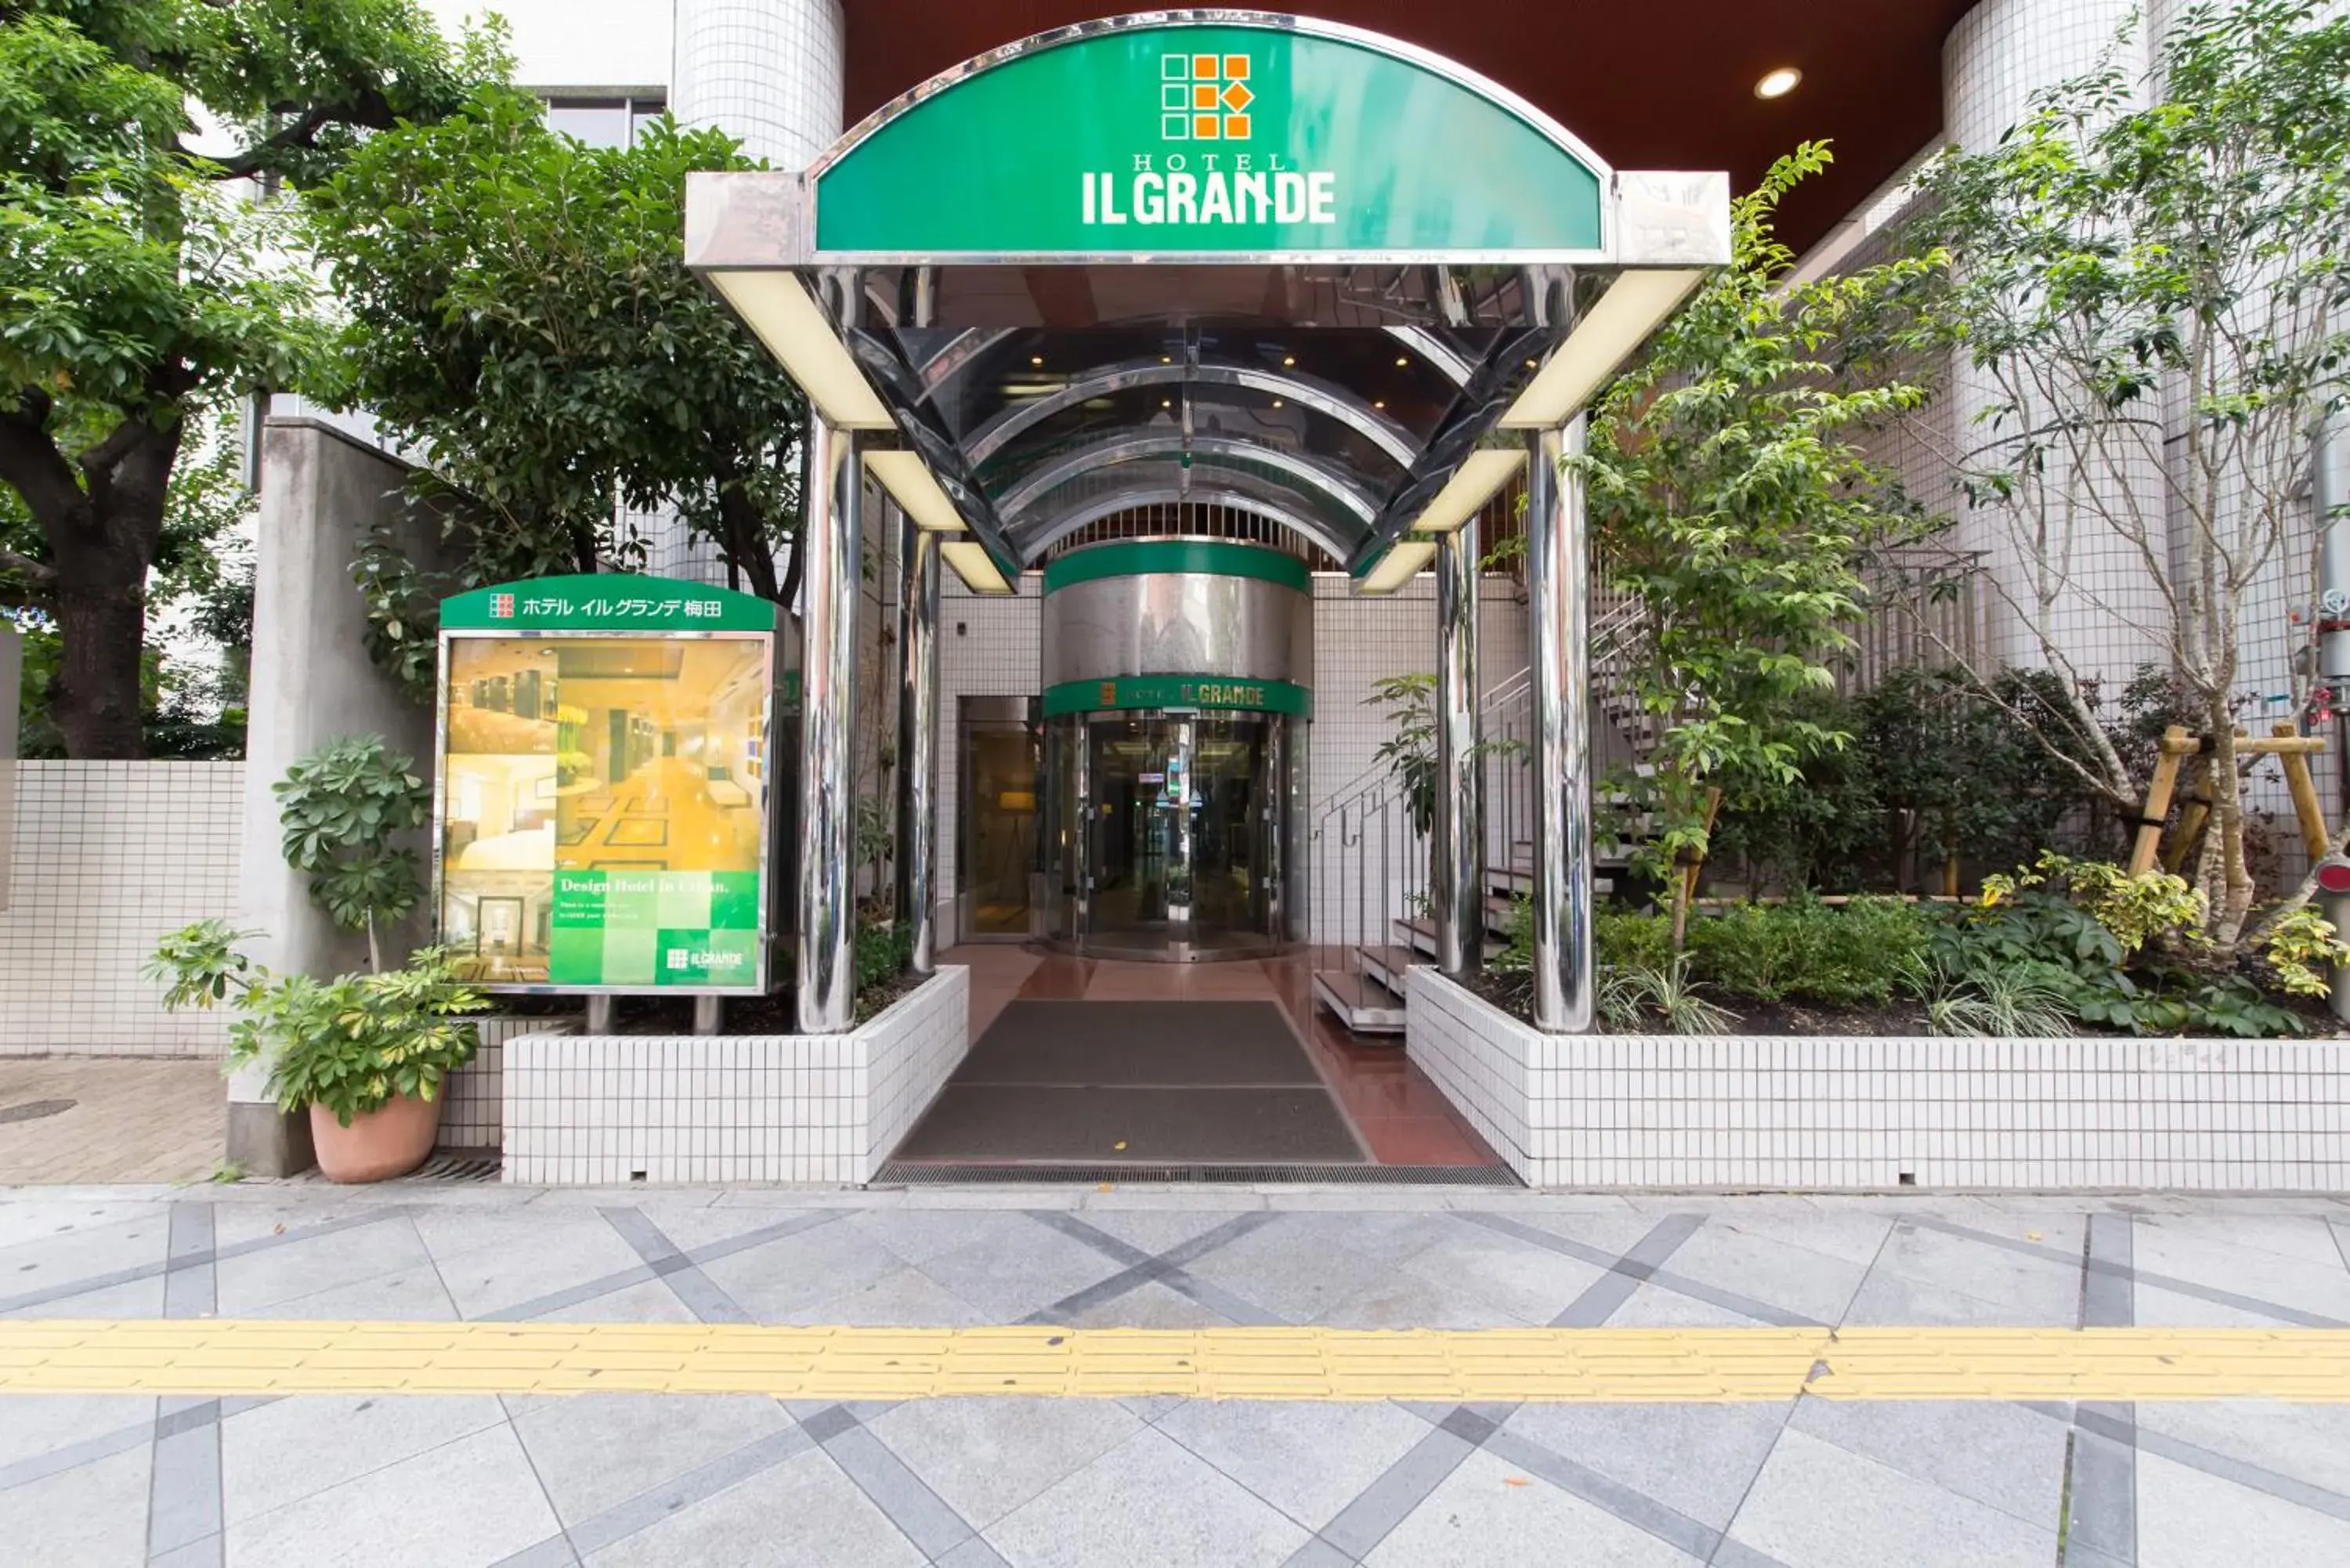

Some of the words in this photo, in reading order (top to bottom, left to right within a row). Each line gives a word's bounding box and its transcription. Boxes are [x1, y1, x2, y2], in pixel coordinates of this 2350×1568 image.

[1133, 154, 1285, 172] HOTEL
[560, 878, 609, 895] Design
[614, 878, 655, 893] Hotel
